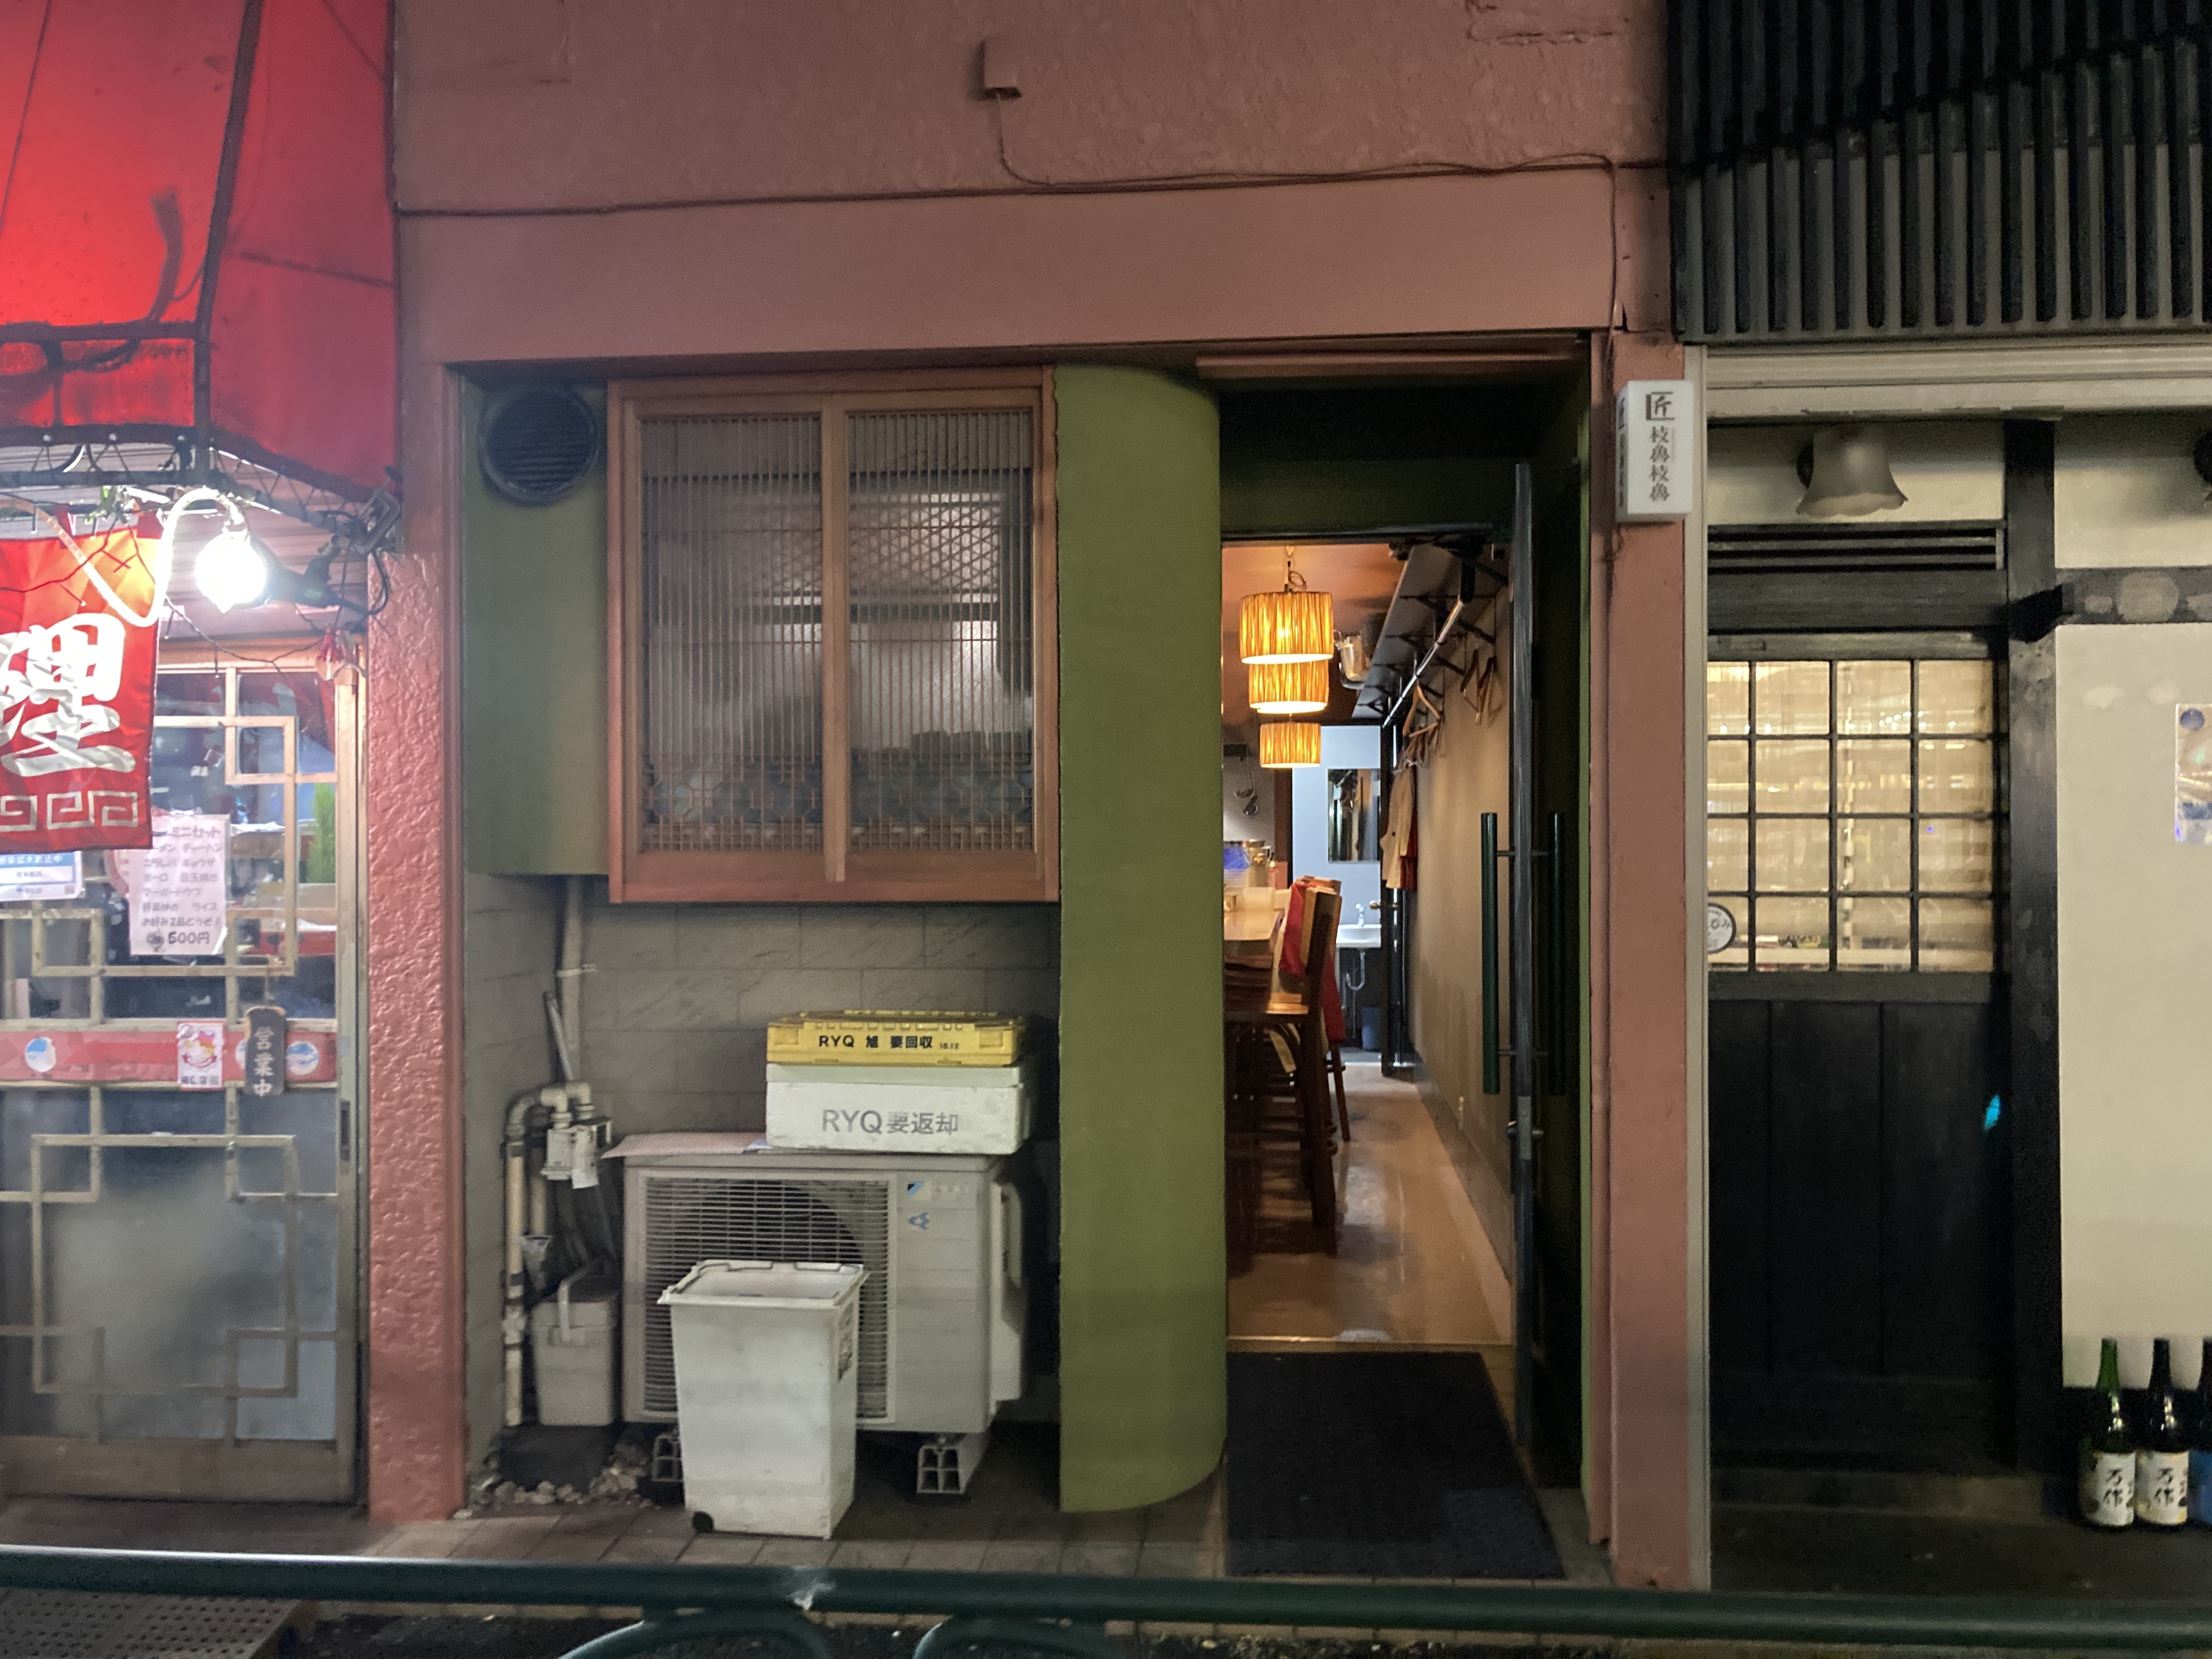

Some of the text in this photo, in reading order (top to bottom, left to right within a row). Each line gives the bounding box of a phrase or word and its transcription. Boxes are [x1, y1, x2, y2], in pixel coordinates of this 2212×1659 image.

[1646, 391, 1675, 421] 匠
[819, 1035, 855, 1048] RYQ
[890, 1035, 933, 1049] 要回収
[254, 1026, 274, 1097] 営業中
